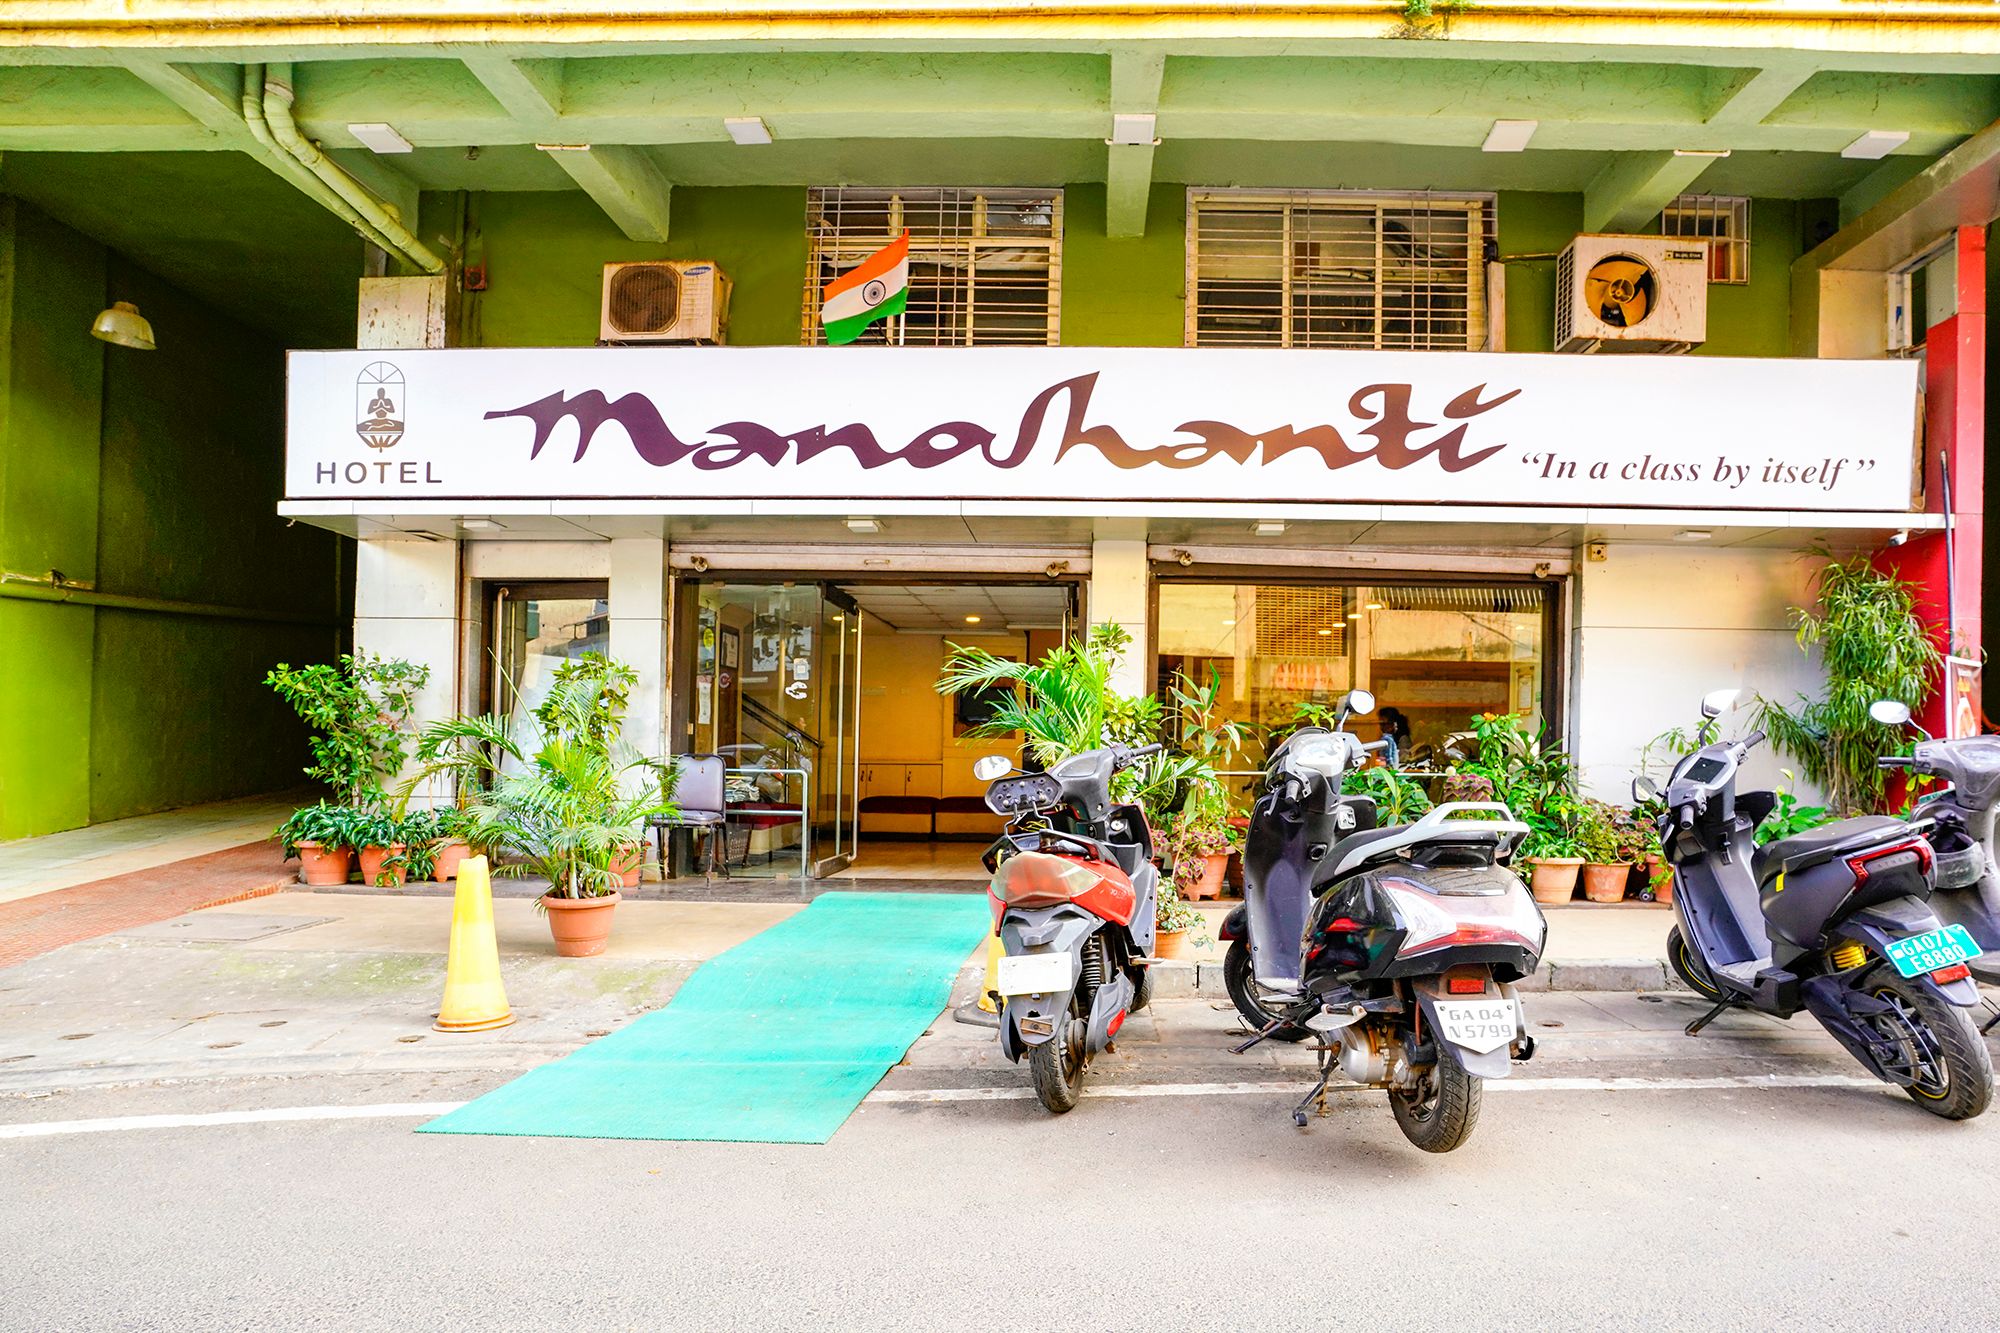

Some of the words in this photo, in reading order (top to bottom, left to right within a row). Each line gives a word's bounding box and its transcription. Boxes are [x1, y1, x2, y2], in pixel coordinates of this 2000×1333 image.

[317, 462, 443, 484] HOTEL
[1588, 461, 1609, 480] a
[1620, 454, 1700, 481] class
[1712, 456, 1752, 490] by
[1900, 929, 1957, 956] GA07A
[1909, 943, 1967, 973] E8880
[1449, 1009, 1475, 1021] GA
[1479, 1009, 1504, 1020] 04
